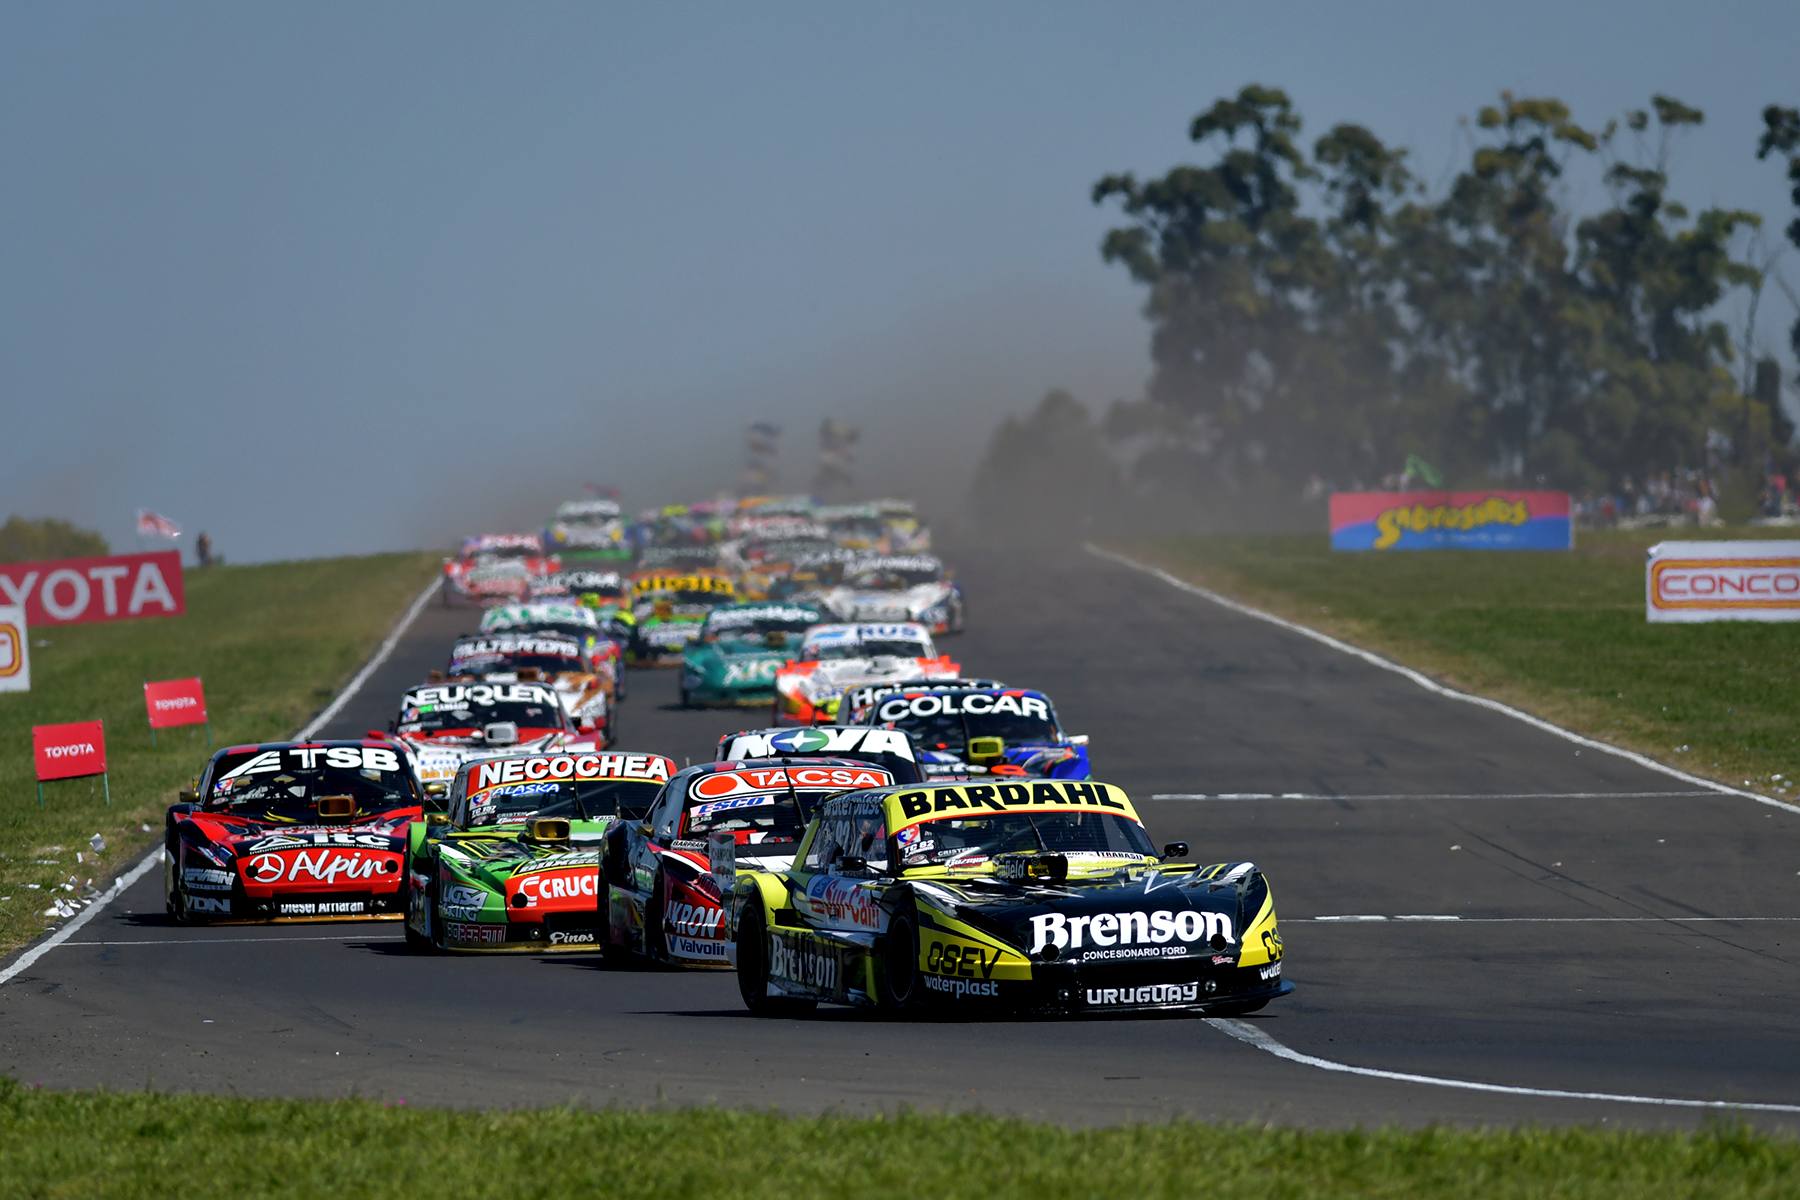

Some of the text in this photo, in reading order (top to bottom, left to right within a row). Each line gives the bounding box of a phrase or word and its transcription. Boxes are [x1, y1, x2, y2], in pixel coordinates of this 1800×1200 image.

[0, 563, 176, 621] YOTA
[154, 696, 197, 710] TOYOTA
[402, 684, 559, 712] NEUQUEN
[45, 742, 94, 758] TOYOTA
[478, 755, 669, 788] NECOCHEA
[751, 769, 881, 787] TACSA
[492, 783, 560, 797] ALASKA
[899, 783, 1125, 819] BARDAHL
[288, 849, 387, 884] Alpin
[1029, 910, 1235, 955] Brenson
[927, 940, 1003, 979] OSEV
[1083, 946, 1187, 961] CONCESIONARIO FORD
[924, 974, 998, 999] waterplast
[1087, 983, 1198, 1005] URUGUAY
